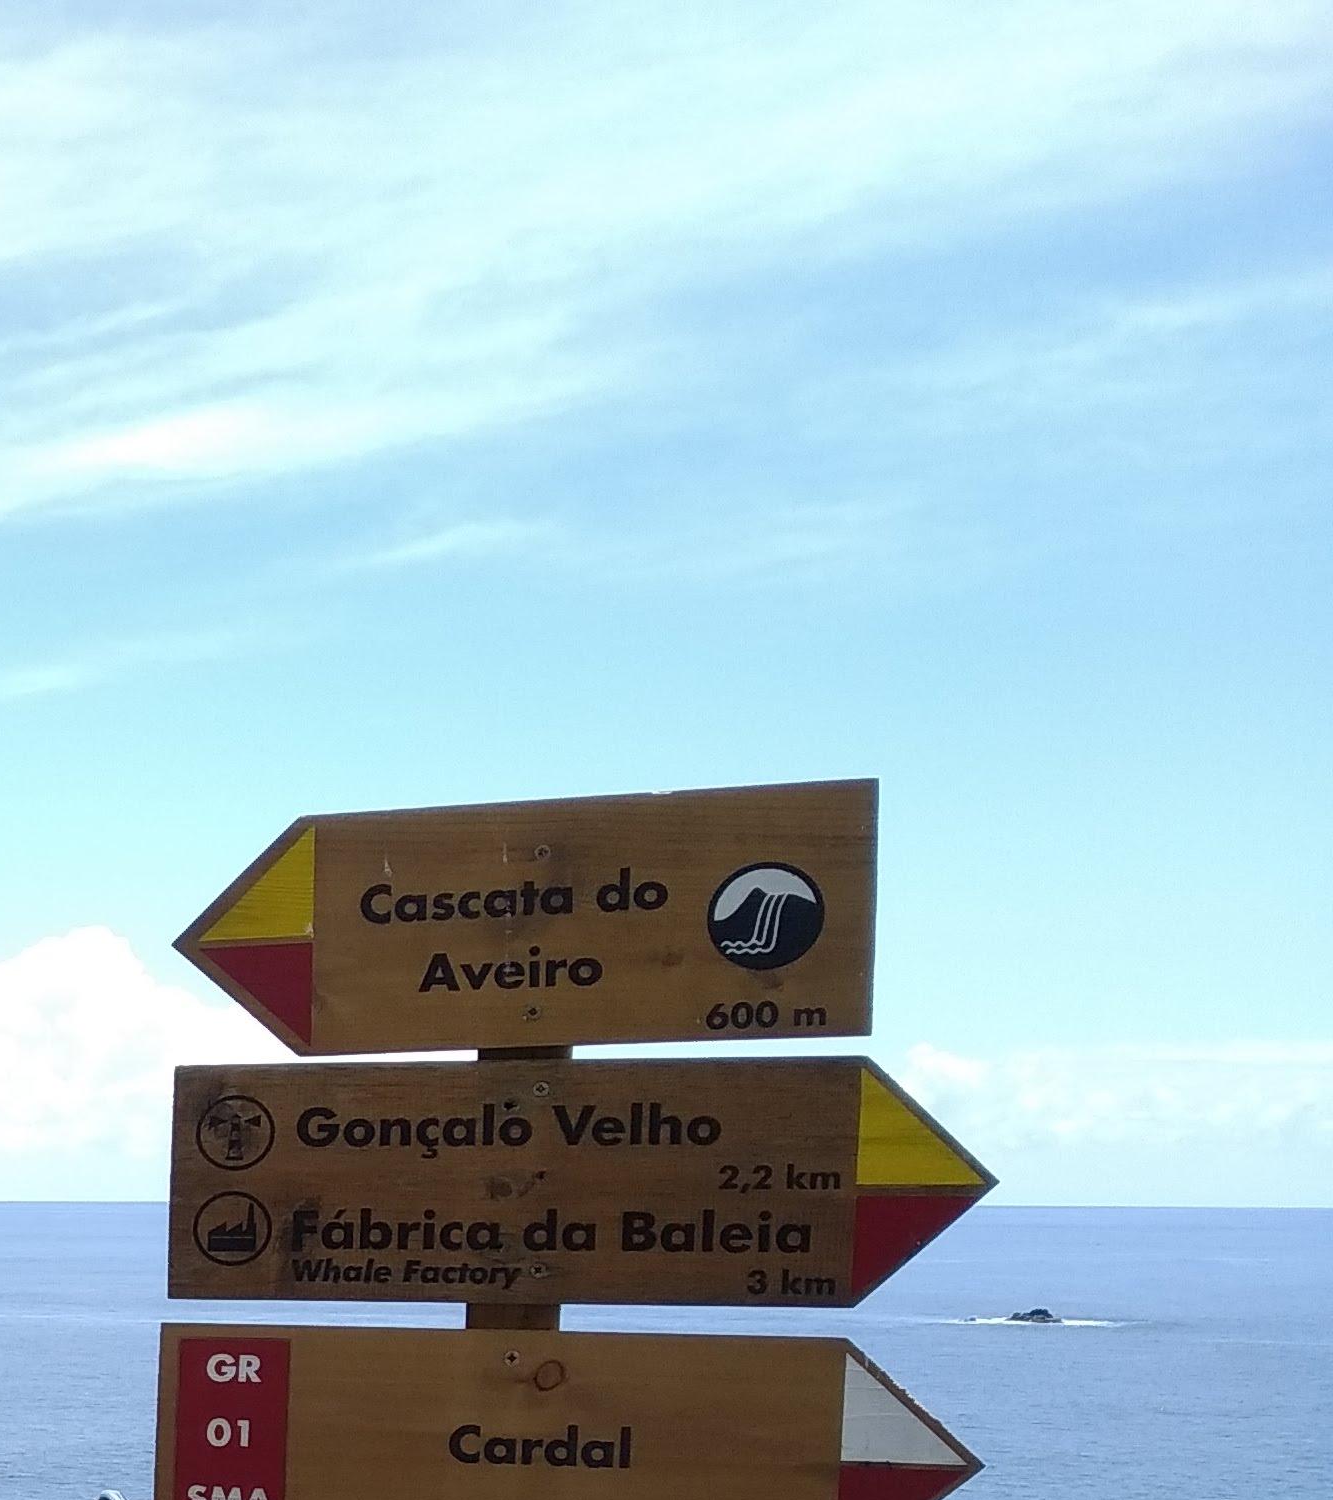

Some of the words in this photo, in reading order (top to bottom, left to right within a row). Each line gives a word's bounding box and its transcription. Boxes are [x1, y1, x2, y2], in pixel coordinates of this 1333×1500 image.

[360, 881, 573, 924] Cascata
[596, 867, 668, 912] do
[419, 946, 602, 992] Aveiro
[706, 1001, 778, 1030] 600
[793, 1006, 827, 1028] m
[296, 1103, 532, 1159] Gonçalo
[558, 1103, 721, 1146] Velho
[718, 1164, 773, 1193] 2,2
[786, 1163, 841, 1191] km
[290, 1208, 503, 1253] Fábrica
[523, 1209, 596, 1251] da
[622, 1209, 811, 1253] Baleia
[291, 1257, 392, 1284] Whale
[402, 1258, 522, 1292] Factory
[746, 1269, 769, 1296] 3
[780, 1267, 837, 1296] km
[206, 1353, 262, 1383] GR
[206, 1417, 251, 1448] 01
[448, 1424, 632, 1469] Cardal
